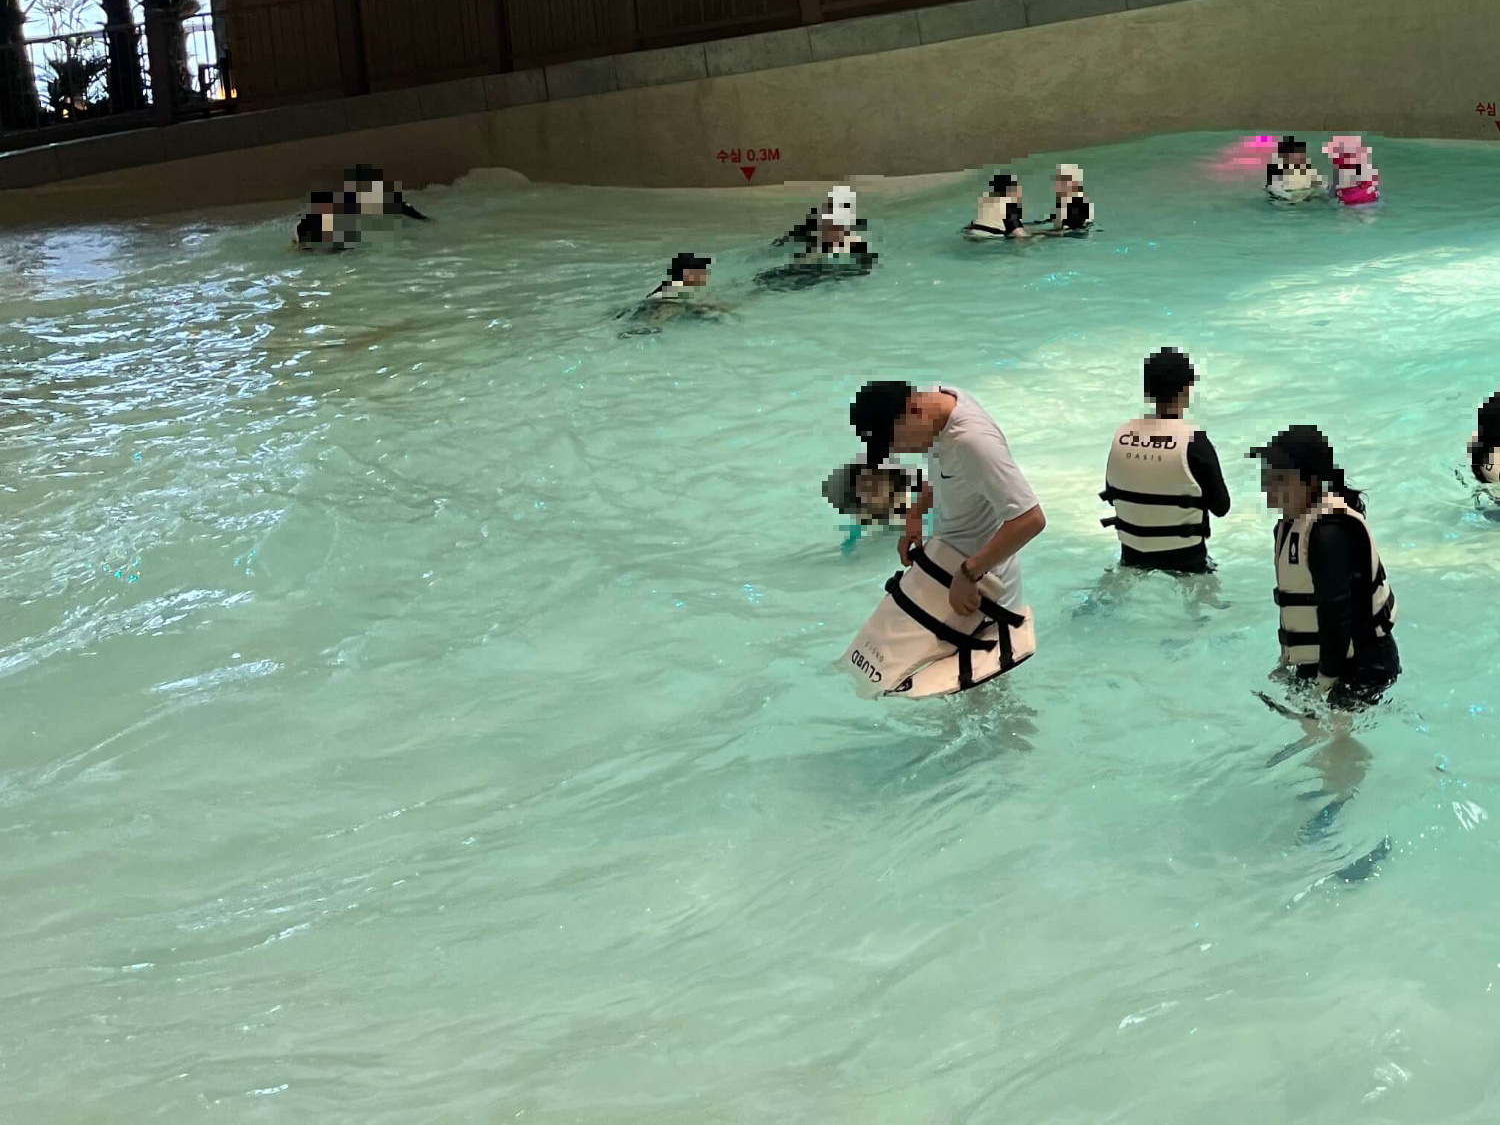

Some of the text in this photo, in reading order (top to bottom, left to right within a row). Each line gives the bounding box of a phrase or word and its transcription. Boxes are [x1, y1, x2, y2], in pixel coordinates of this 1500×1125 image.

[1475, 102, 1496, 116] 수심
[717, 148, 780, 163] 수심 0.3M
[852, 649, 882, 683] CLUBD
